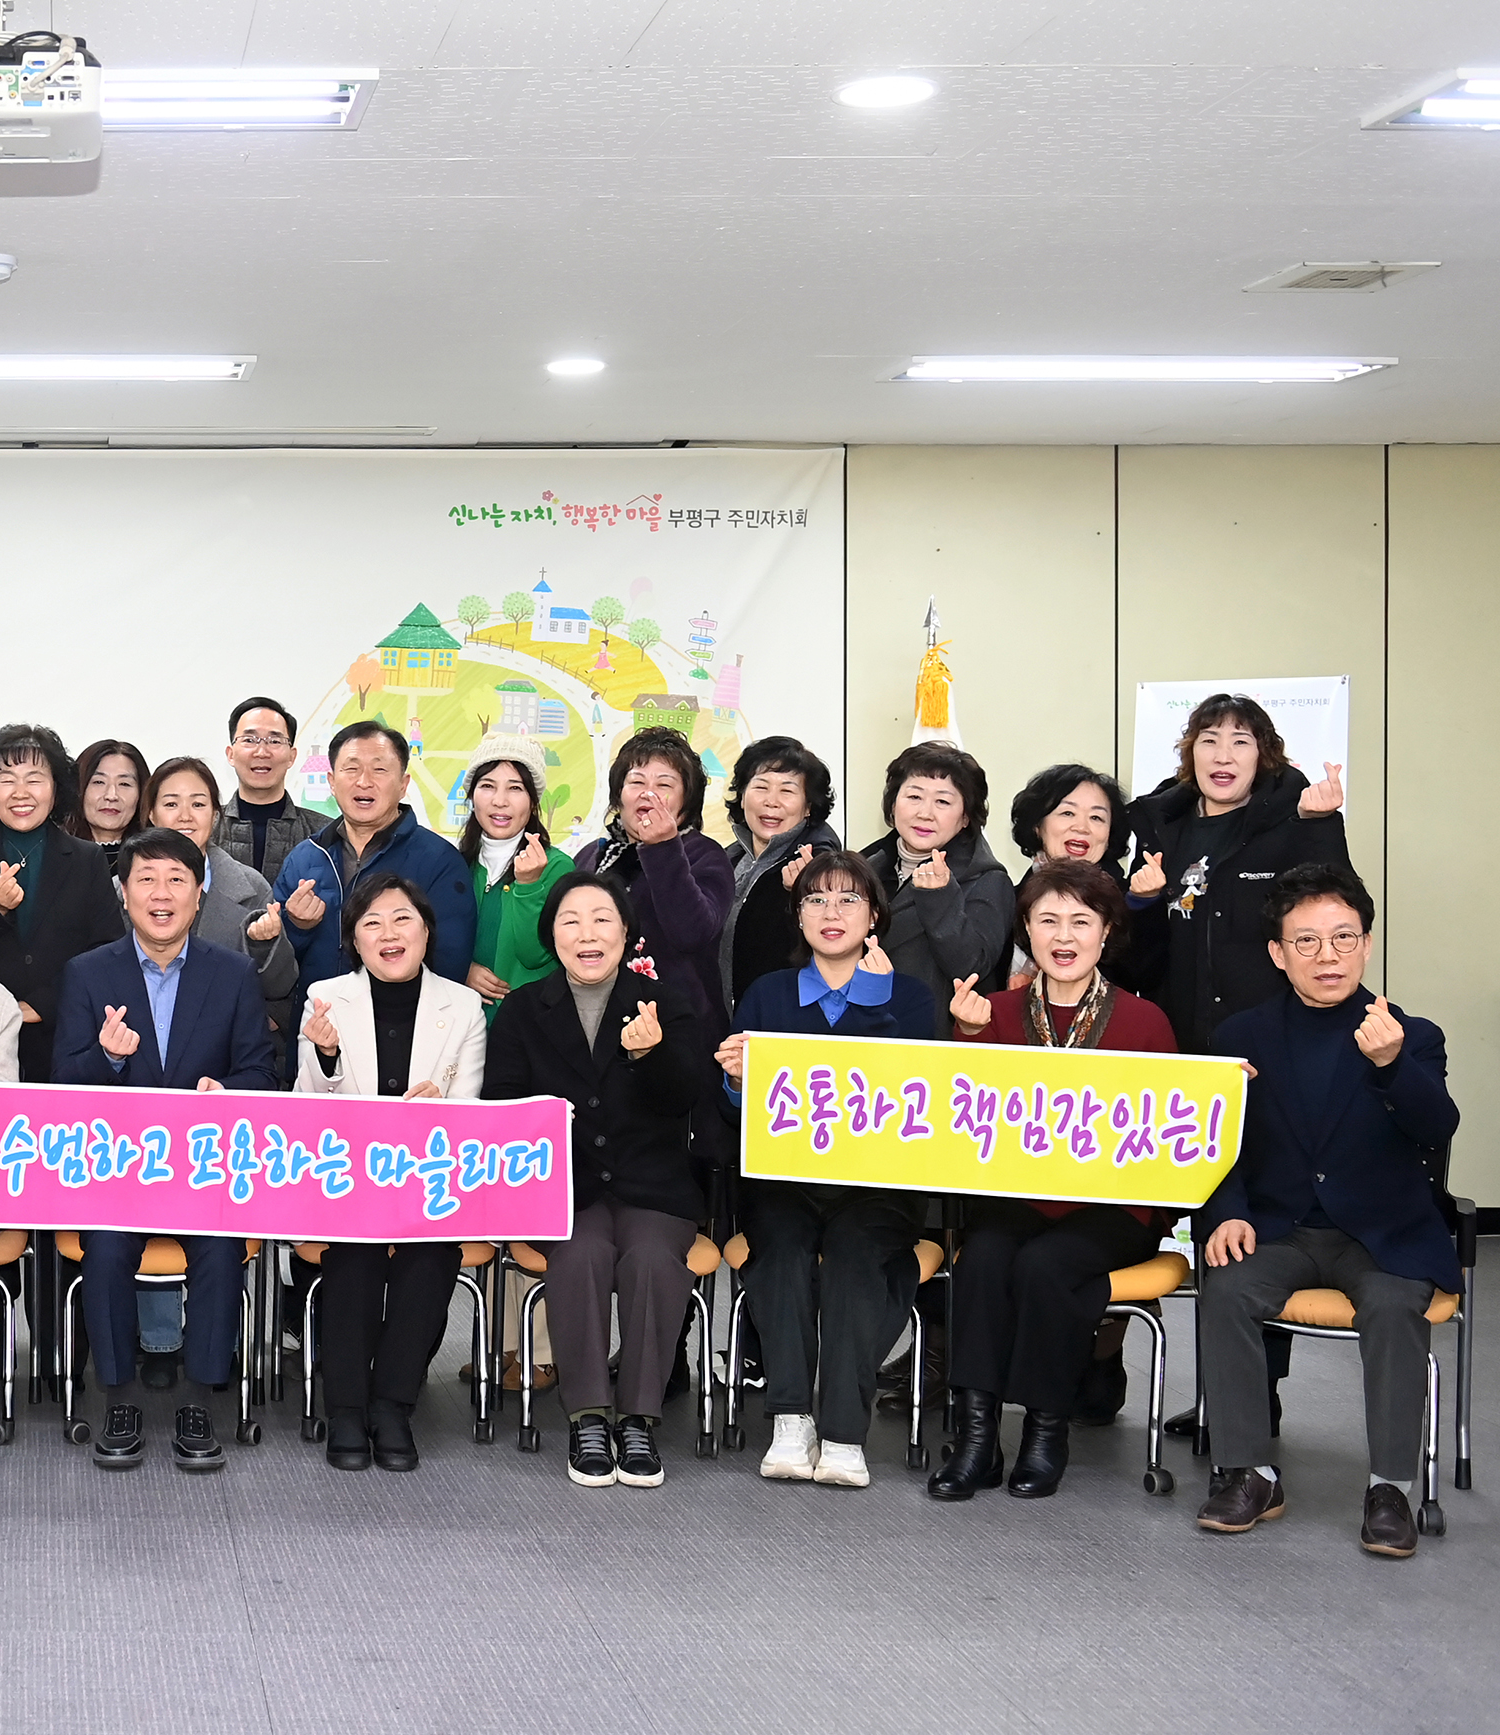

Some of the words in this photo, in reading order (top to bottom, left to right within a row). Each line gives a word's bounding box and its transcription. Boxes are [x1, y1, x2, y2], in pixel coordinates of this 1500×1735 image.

[448, 503, 506, 528] 신나는
[510, 505, 557, 526] 자치,
[561, 503, 621, 532] 행복한
[625, 504, 662, 532] 마을
[667, 508, 721, 528] 부평구
[727, 508, 808, 529] 주민자치회
[768, 1070, 930, 1149] 소통하고
[192, 1123, 352, 1200] 포용하는
[370, 1133, 548, 1217] 마을리더
